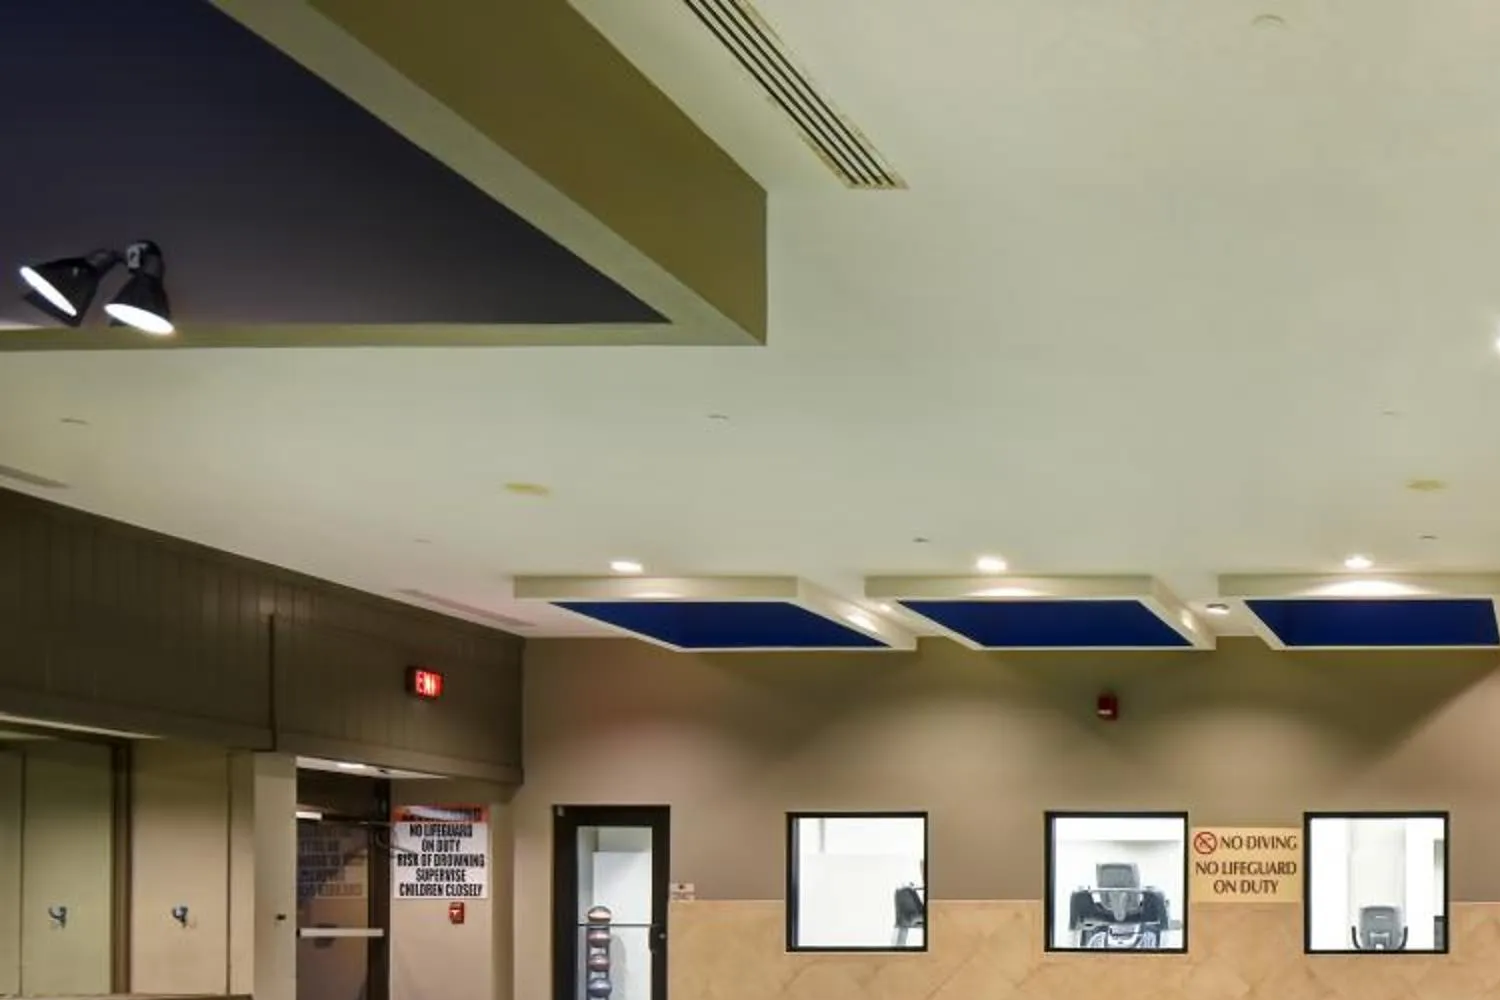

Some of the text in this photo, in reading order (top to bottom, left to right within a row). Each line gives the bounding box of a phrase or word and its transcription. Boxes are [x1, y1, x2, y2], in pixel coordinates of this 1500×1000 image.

[410, 823, 472, 838] NO LIFEGUARD
[422, 839, 460, 852] ON DUTY
[1220, 835, 1297, 850] NO DIVING
[398, 854, 484, 868] RISK OF DROWNING
[416, 868, 465, 882] SUPERVISE
[1195, 861, 1297, 876] NO LIFEGUARD
[400, 883, 482, 897] CHILDREN CLOSELY
[1213, 879, 1279, 894] ON DUTY
